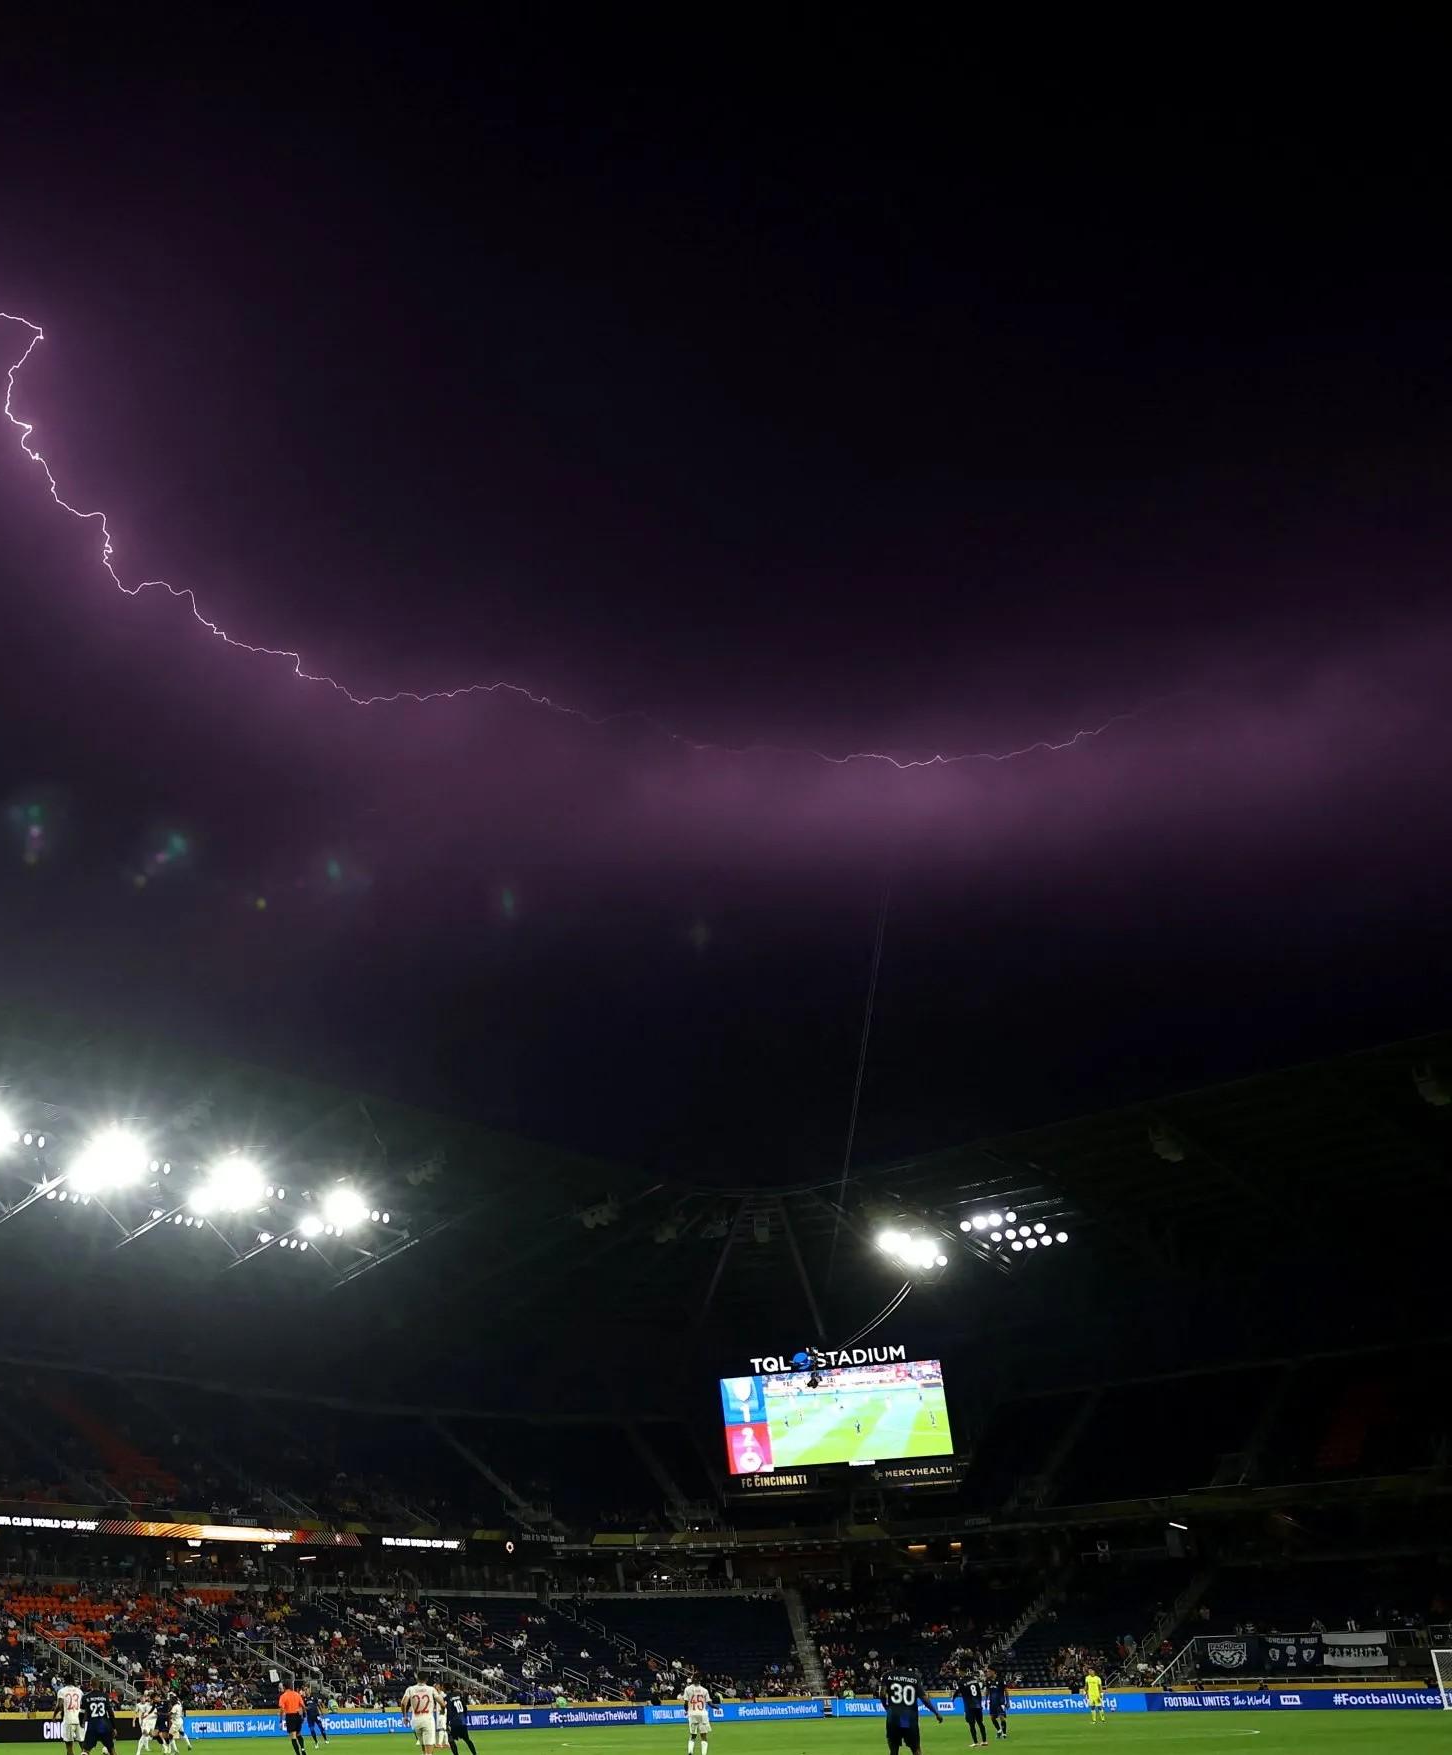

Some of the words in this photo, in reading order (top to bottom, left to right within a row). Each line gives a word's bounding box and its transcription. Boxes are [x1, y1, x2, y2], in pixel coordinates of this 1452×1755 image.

[750, 1356, 792, 1373] TQL
[817, 1345, 906, 1368] STADIUM
[885, 1466, 953, 1478] MERCYHEALTH
[741, 1478, 753, 1489] FC
[754, 1475, 807, 1488] CINCINNATI
[12, 1516, 32, 1527] CLUB
[33, 1518, 60, 1529] WORLD
[61, 1519, 78, 1530] CUP
[890, 1683, 916, 1706] 30
[970, 1684, 978, 1697] 8
[412, 1694, 430, 1715] 22
[453, 1699, 464, 1713] 10
[1164, 1696, 1202, 1707] FOOTBALL
[1203, 1696, 1230, 1706] UNITES
[1233, 1695, 1246, 1706] the
[1246, 1694, 1271, 1707] World
[89, 1702, 105, 1718] 23
[738, 1704, 818, 1717] #FootballUnitesTheWorld
[845, 1702, 876, 1713] FOOTBALL
[471, 1714, 489, 1726] UNITES
[223, 1721, 245, 1733] UNITES
